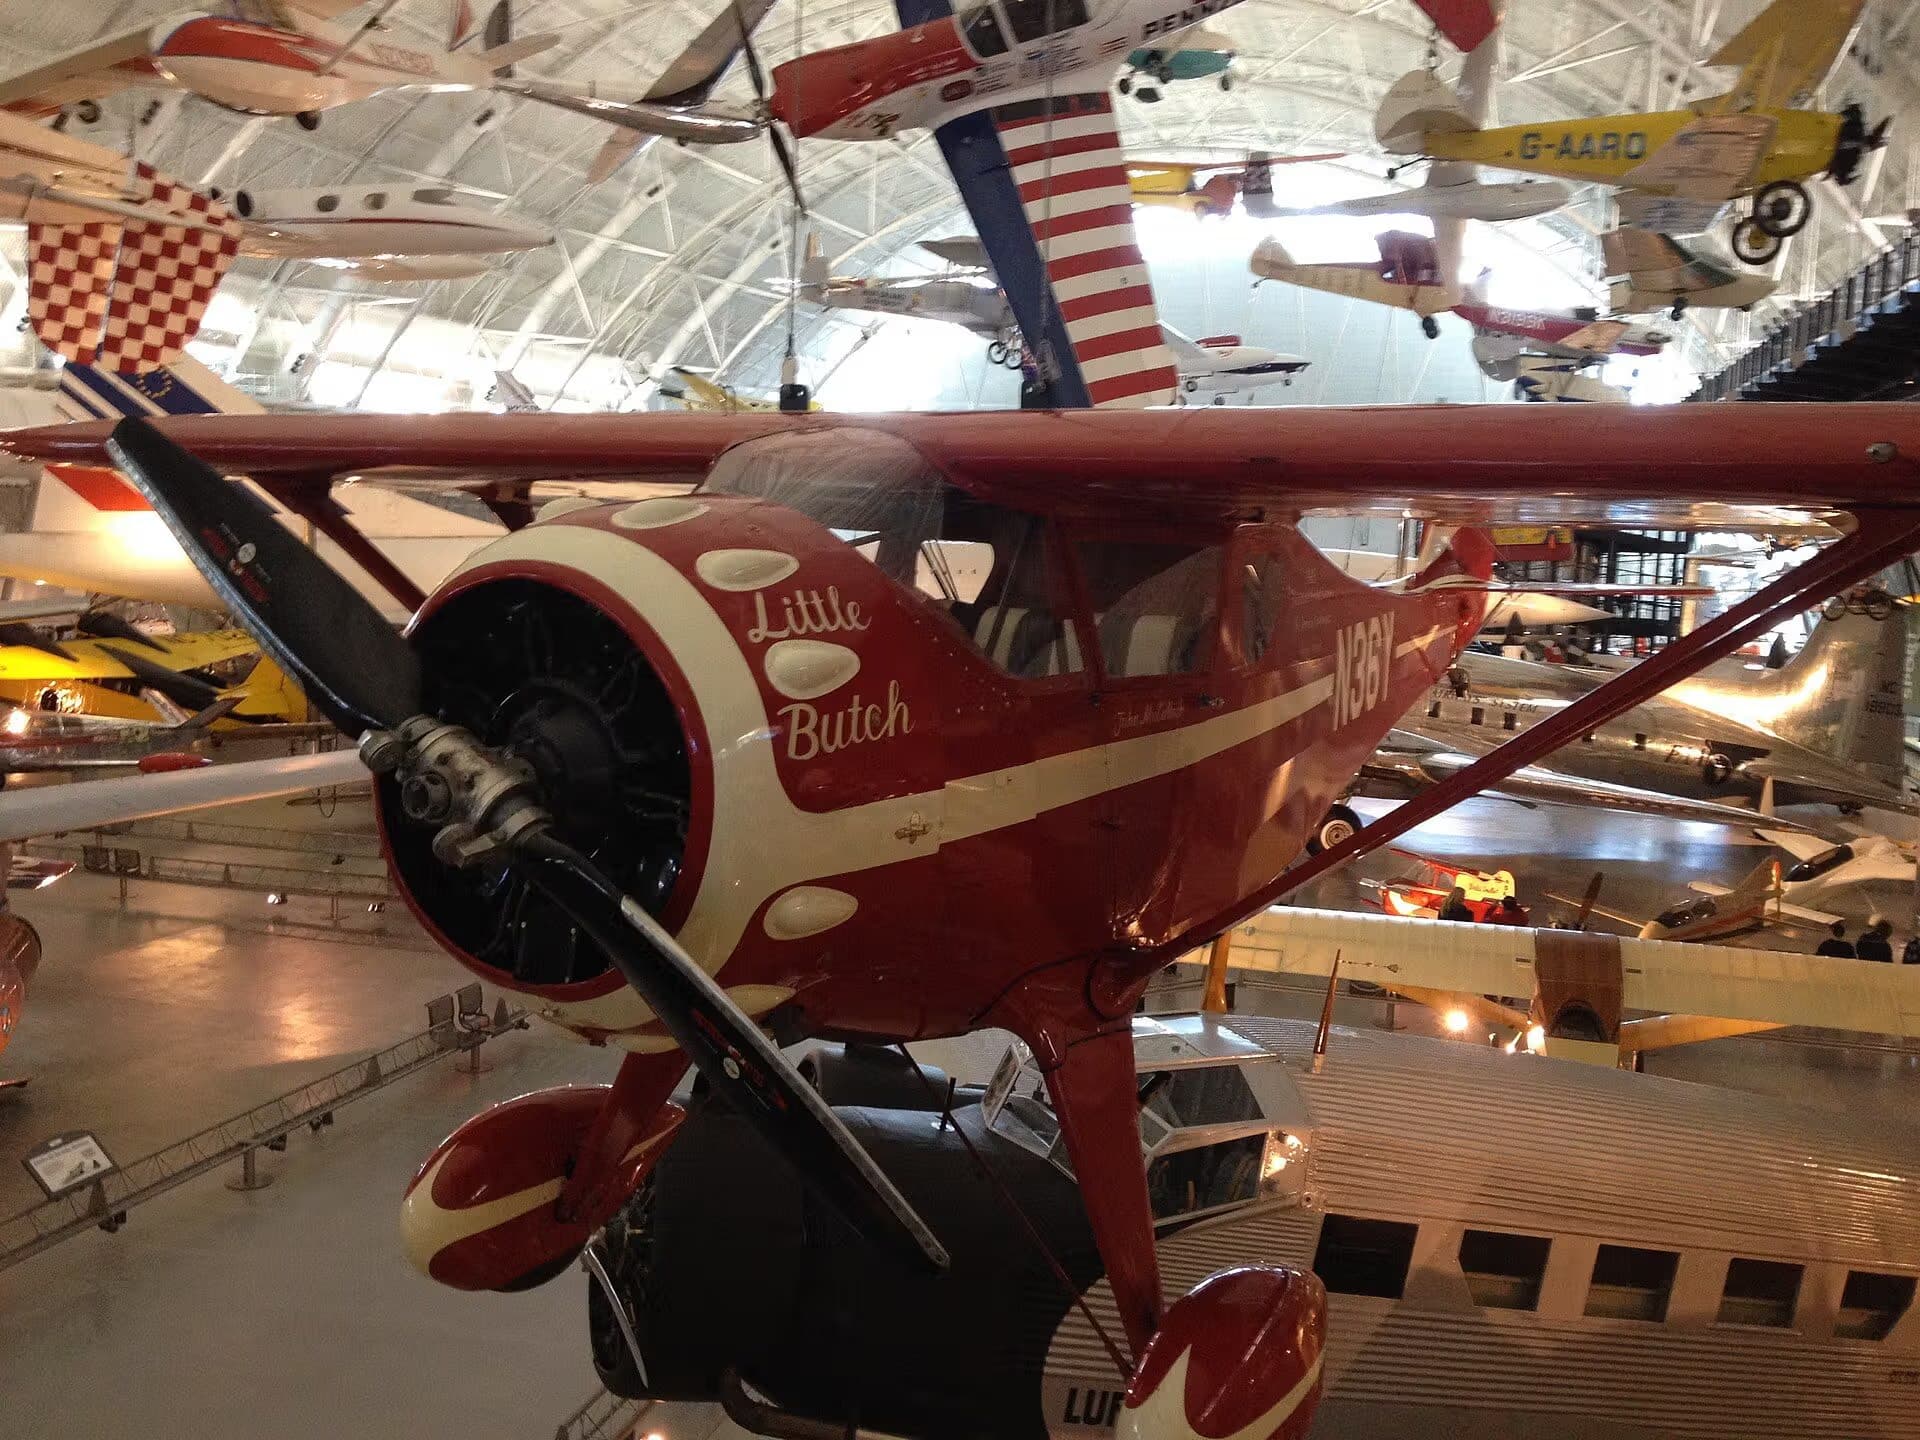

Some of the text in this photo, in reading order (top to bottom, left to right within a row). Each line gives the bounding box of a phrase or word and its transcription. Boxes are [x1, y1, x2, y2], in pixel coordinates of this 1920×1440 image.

[1520, 132, 1648, 160] G-AARO
[747, 585, 873, 643] Little
[1333, 608, 1395, 732] N36Y
[777, 679, 916, 761] Butch
